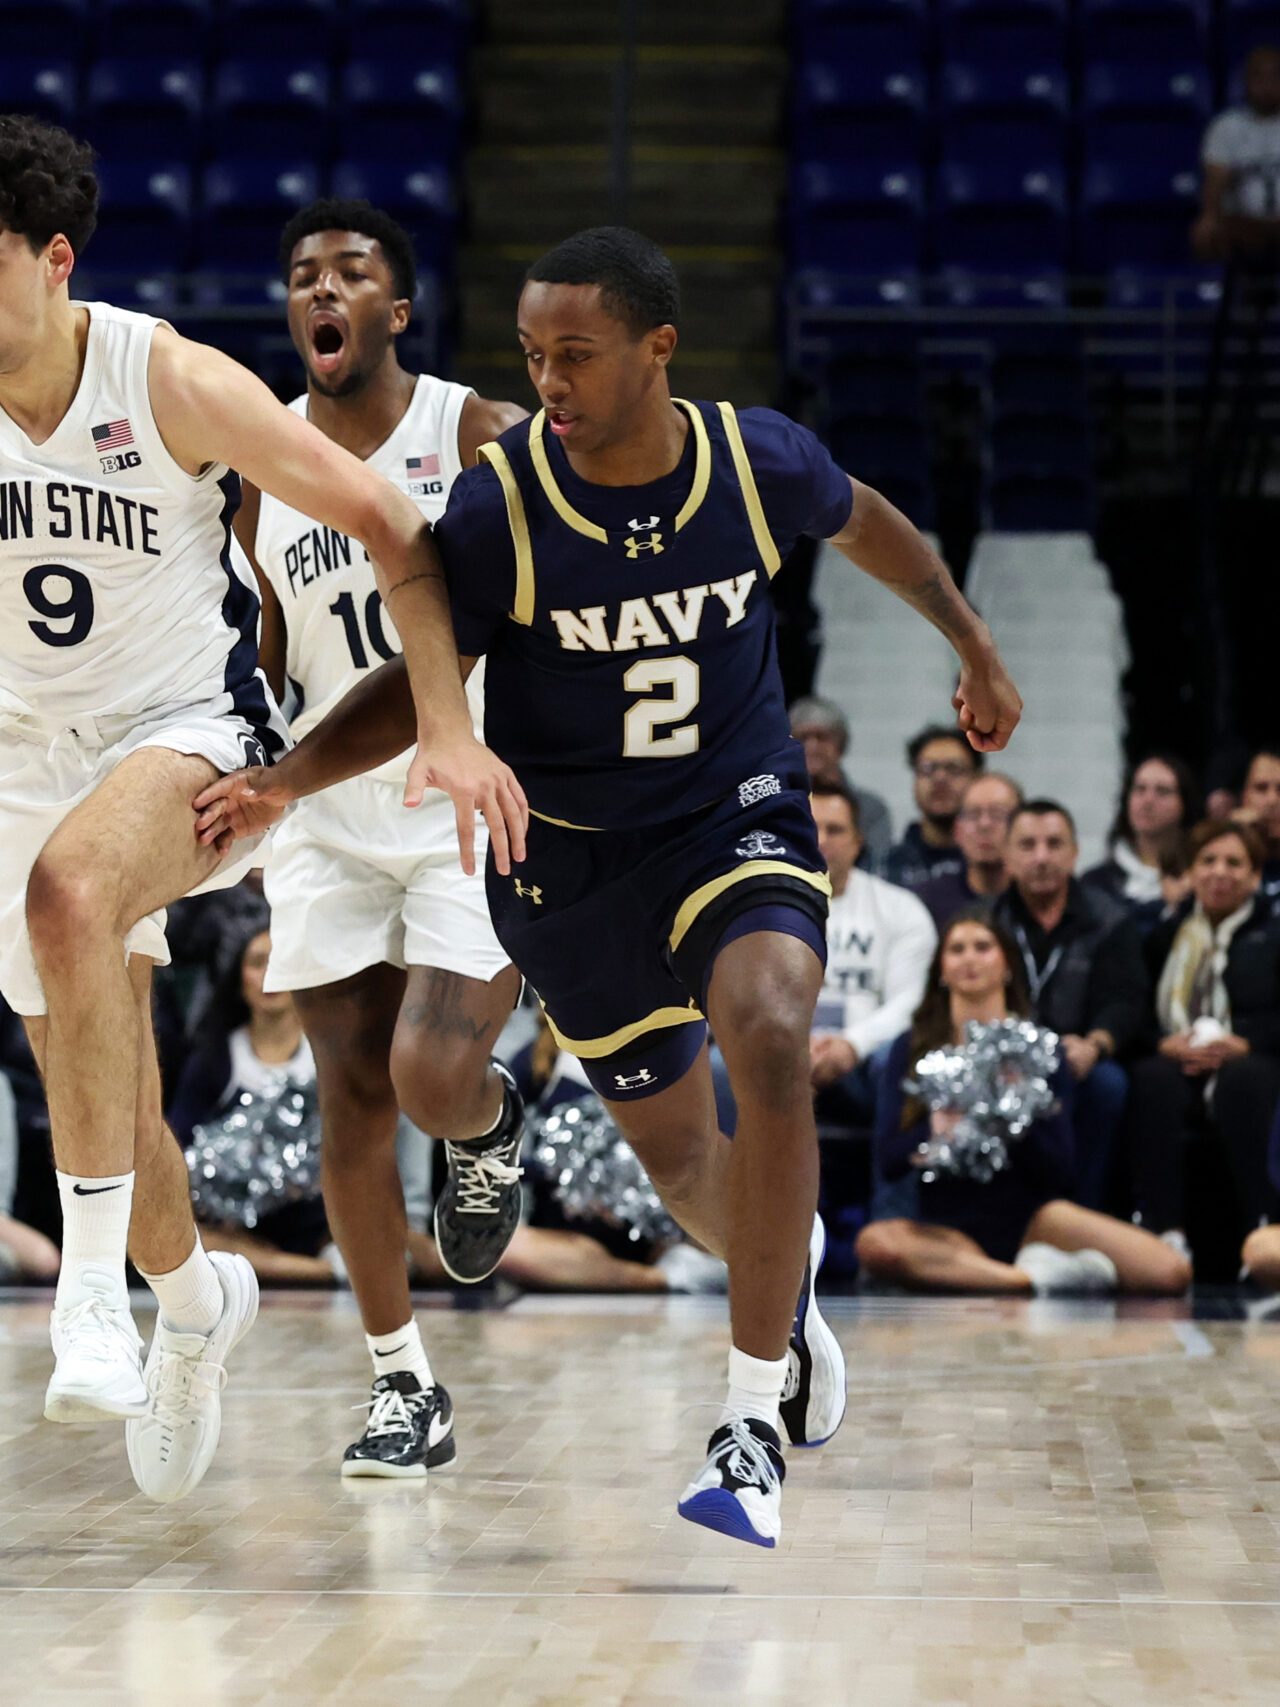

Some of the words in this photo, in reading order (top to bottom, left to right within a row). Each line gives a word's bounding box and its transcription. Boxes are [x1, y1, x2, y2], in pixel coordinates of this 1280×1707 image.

[46, 482, 161, 556] STATE
[284, 525, 352, 599] PENN
[22, 564, 94, 648] 9
[550, 569, 757, 652] NAVY
[622, 655, 700, 758] 2
